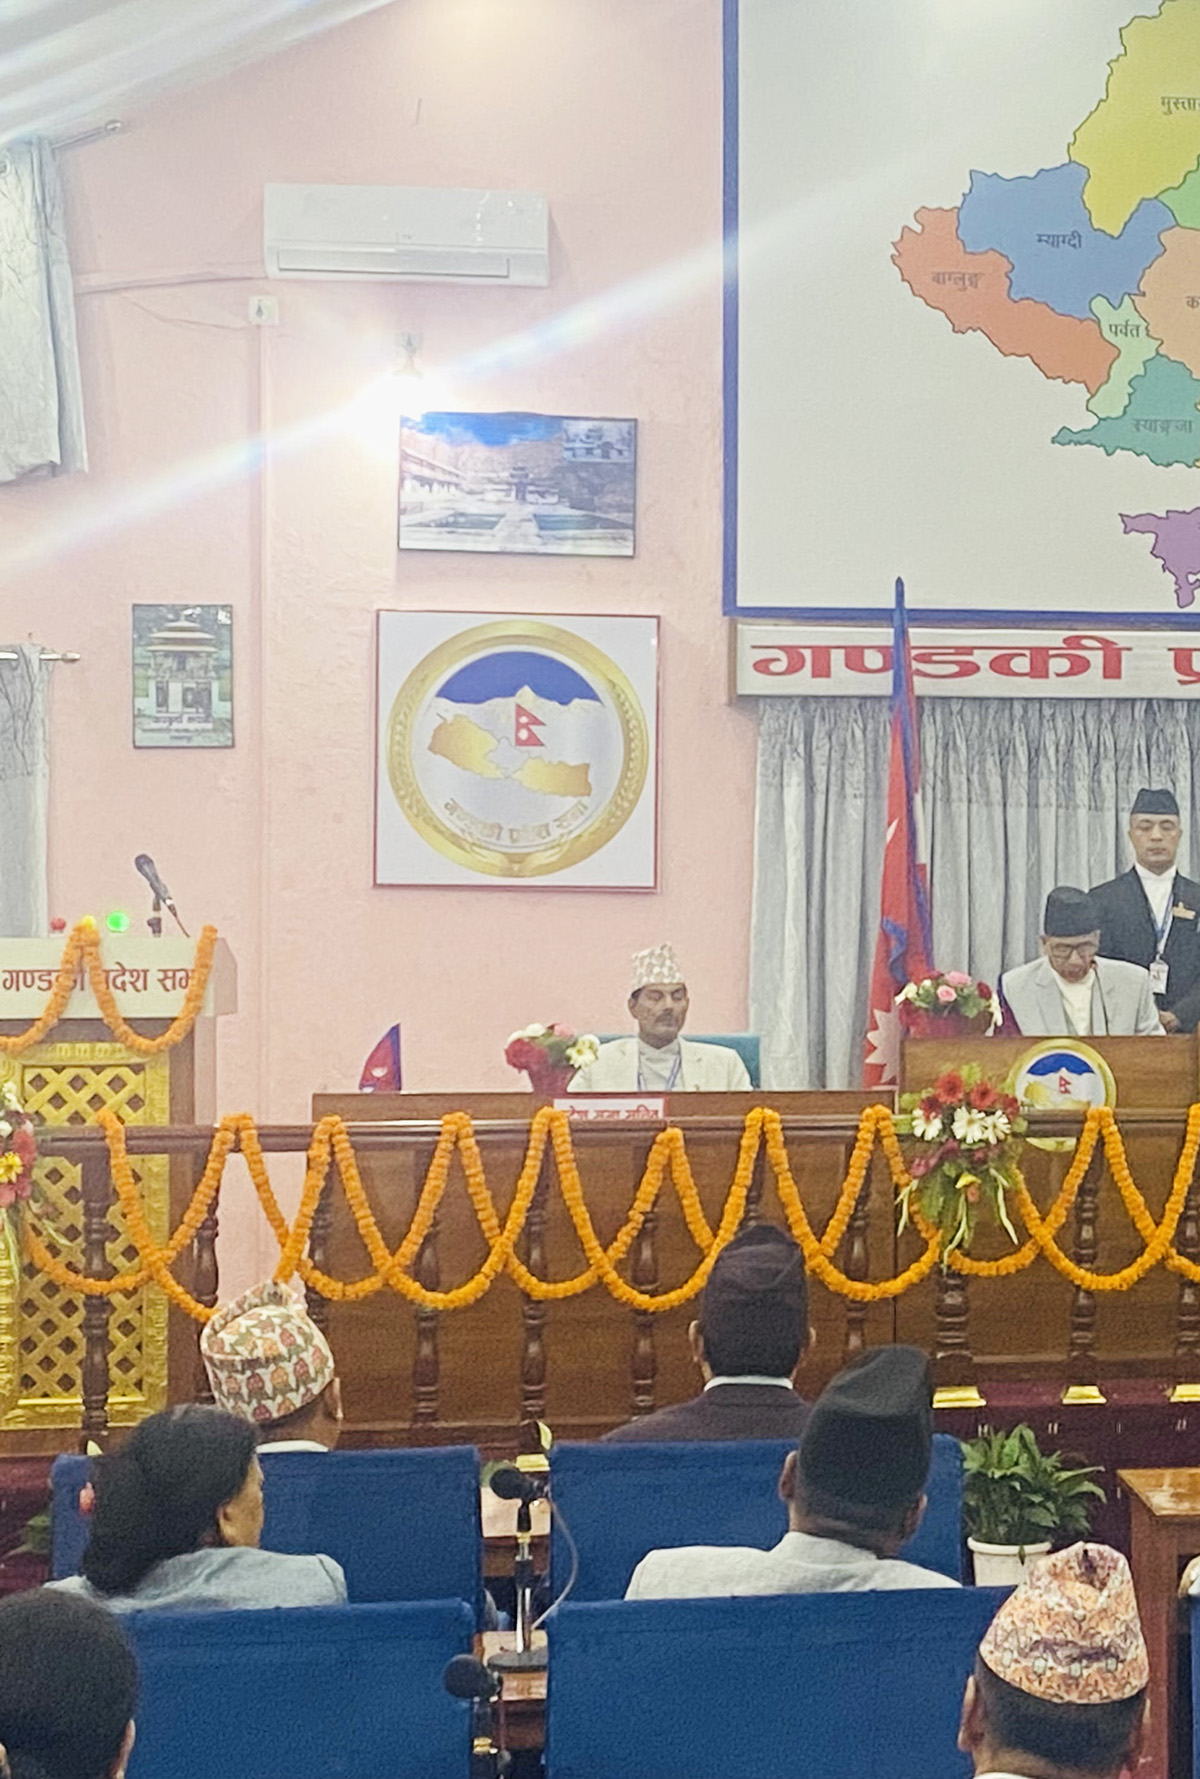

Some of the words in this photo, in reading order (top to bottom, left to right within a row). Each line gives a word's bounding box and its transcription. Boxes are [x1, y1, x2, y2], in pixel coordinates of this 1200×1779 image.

[1036, 230, 1082, 250] म्याग्दी
[1108, 318, 1141, 338] पर्वत
[751, 634, 1133, 680] गण्डकी
